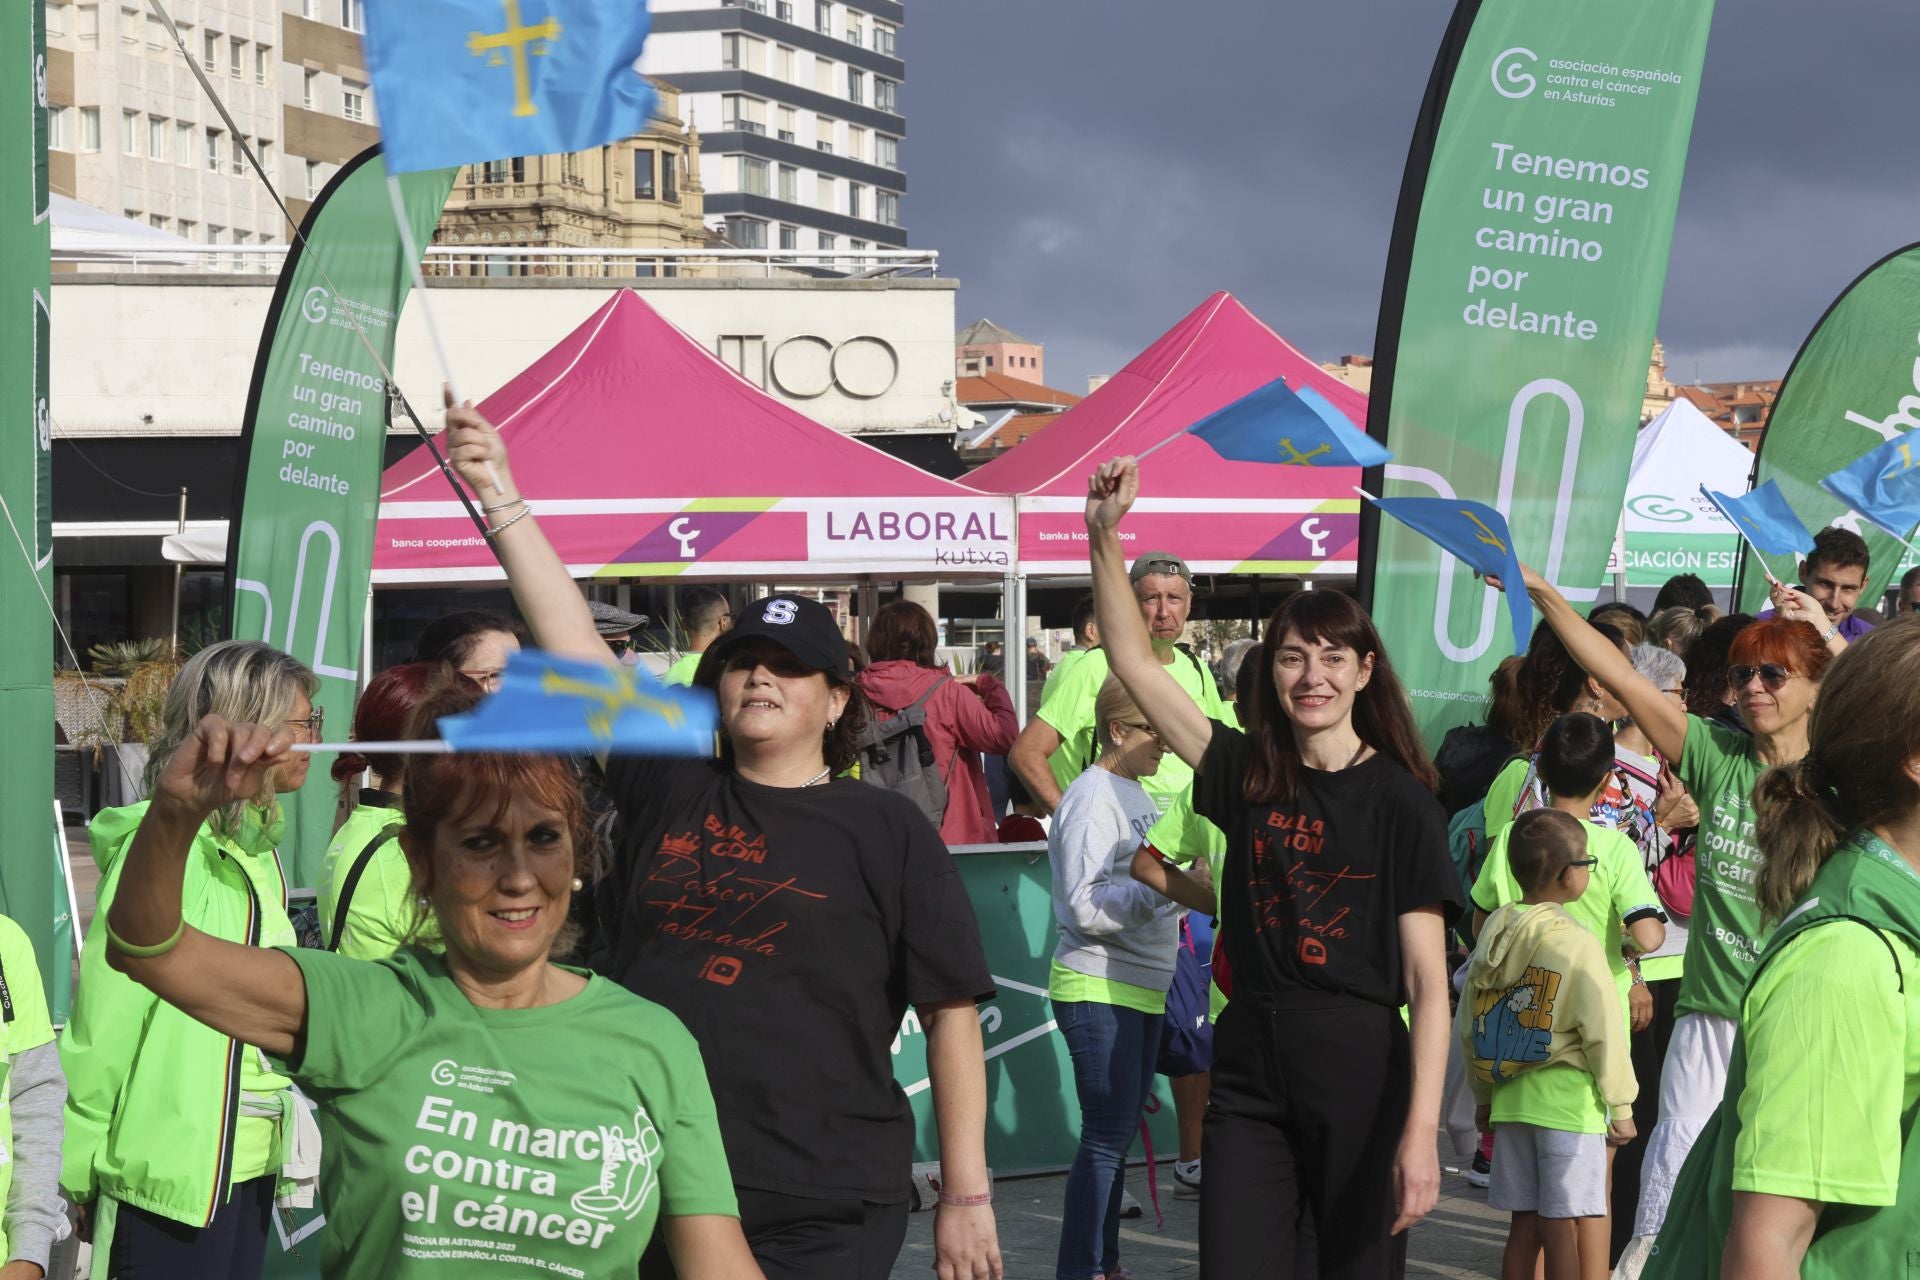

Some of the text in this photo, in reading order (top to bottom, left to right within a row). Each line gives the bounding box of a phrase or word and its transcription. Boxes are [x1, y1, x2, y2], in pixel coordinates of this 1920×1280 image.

[1546, 74, 1652, 96] contra el cáncer
[1549, 58, 1682, 84] asociación española
[1543, 90, 1616, 107] en Asturias
[1491, 142, 1650, 189] Tenemos
[1482, 188, 1613, 224] un gran
[1475, 228, 1603, 262] camino
[1468, 265, 1529, 293] por
[1463, 298, 1598, 340] delante
[299, 353, 384, 393] Tenemos
[293, 384, 362, 415] un gran
[288, 412, 355, 441] camino
[282, 438, 315, 459] por
[279, 462, 349, 495] delante
[826, 511, 1008, 541] LABORAL
[1039, 531, 1070, 540] banka
[392, 536, 487, 548] banca cooperativa
[935, 547, 1008, 566] kutxa
[762, 599, 799, 625] S
[1711, 805, 1736, 832] En
[710, 841, 768, 864] CON
[1706, 921, 1761, 955] LBORAL
[1732, 947, 1758, 964] kutx
[415, 1095, 478, 1141] En
[404, 1145, 557, 1197] contra
[401, 1184, 616, 1249] el cáncer
[439, 1237, 450, 1246] EN
[451, 1238, 495, 1250] ASTURIAS
[451, 1249, 498, 1262] ESPAÑOLA
[499, 1253, 535, 1266] CONTRA
[535, 1259, 547, 1269] EL
[548, 1261, 585, 1279] CÁNCER
